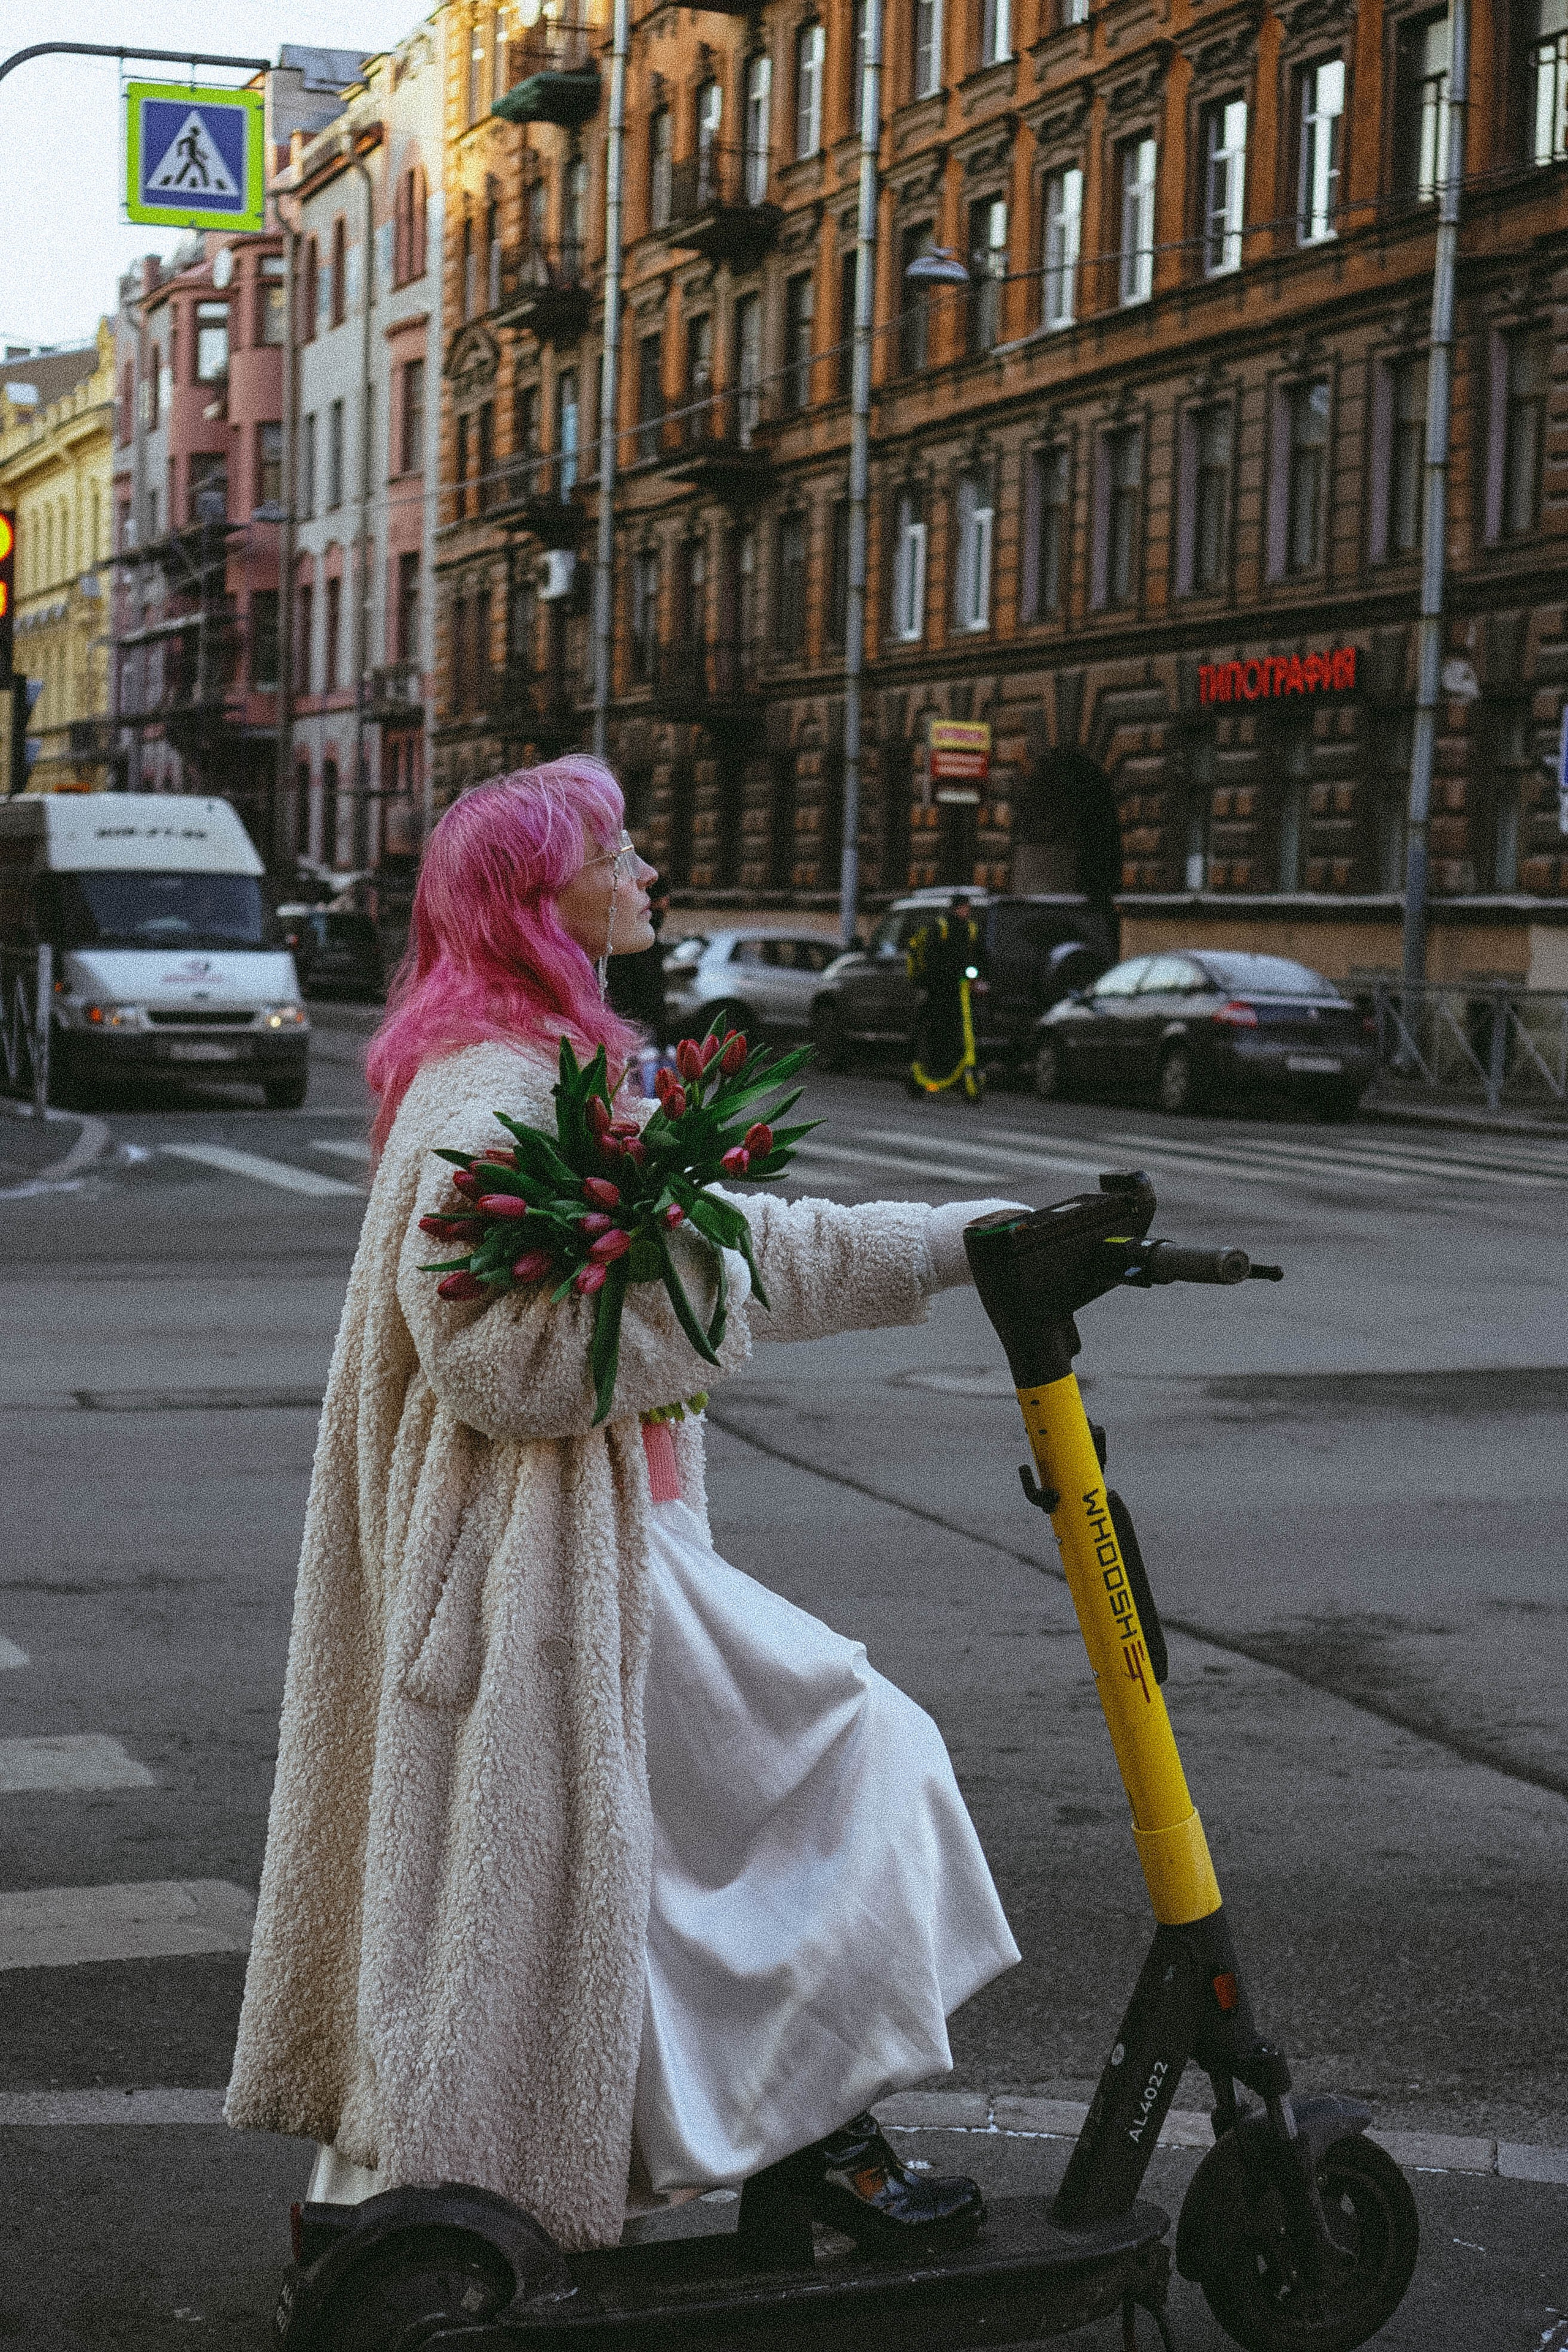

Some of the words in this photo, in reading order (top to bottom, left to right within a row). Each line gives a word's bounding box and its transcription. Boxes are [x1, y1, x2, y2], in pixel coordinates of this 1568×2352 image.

[1199, 646, 1357, 704] ТИПОГРАФИЯ
[1082, 1488, 1137, 1640] WHOOSH
[1129, 2062, 1168, 2143] AL4022
